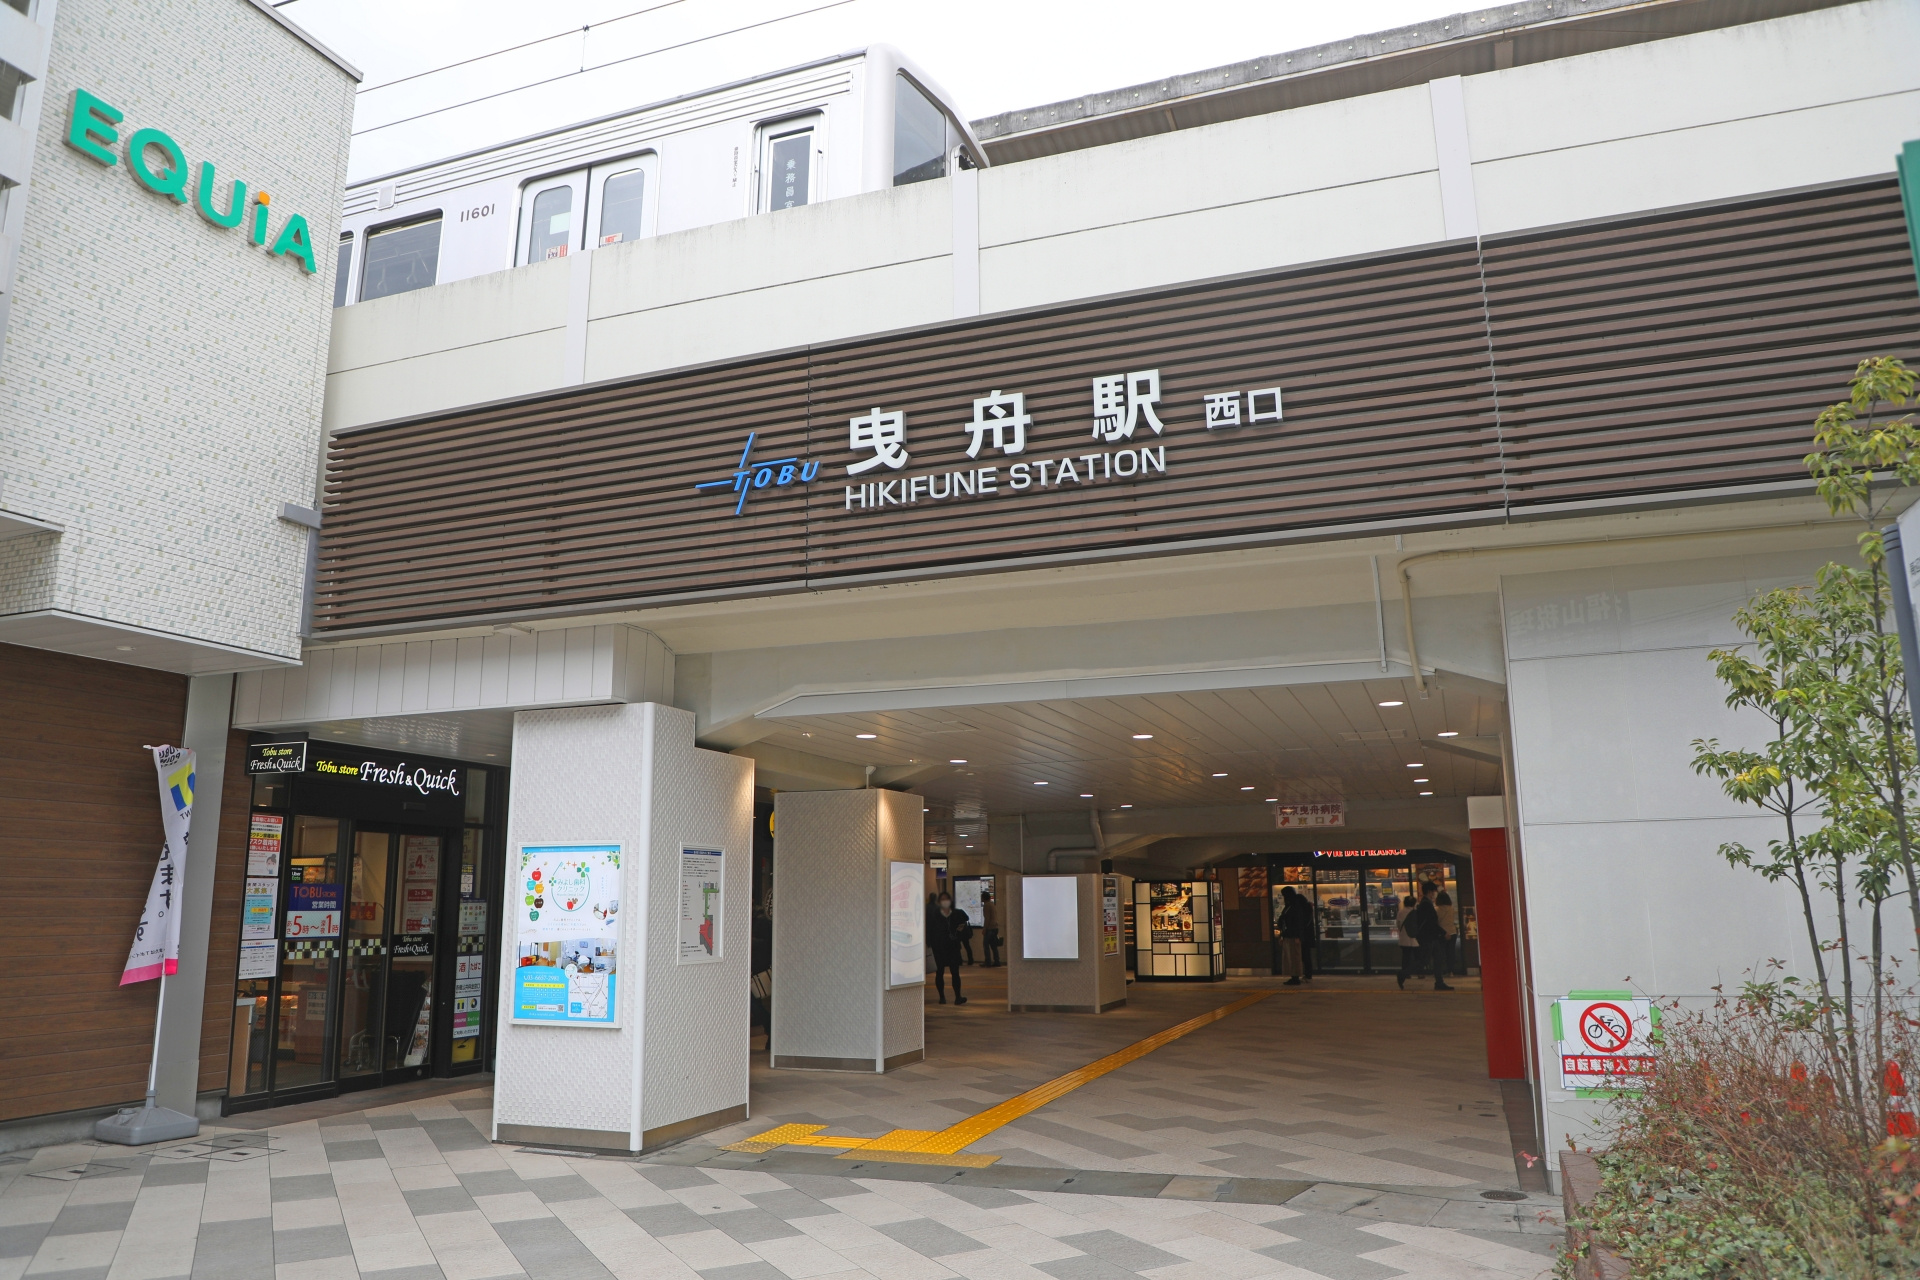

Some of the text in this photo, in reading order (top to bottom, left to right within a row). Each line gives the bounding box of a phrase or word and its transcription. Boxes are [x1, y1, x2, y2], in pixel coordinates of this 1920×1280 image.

[64, 88, 317, 275] EQUiA
[459, 203, 496, 224] 11601
[845, 368, 1285, 477] 曳舟駅 西口
[845, 445, 1167, 511] HIKIFUNE STATION
[262, 746, 293, 757] Tobu store
[316, 760, 338, 773] Tobu
[338, 765, 359, 776] store
[1278, 803, 1341, 816] 東京曳舟病院
[1297, 816, 1325, 825] 東口
[293, 886, 323, 898] TOBU
[311, 900, 337, 909] 営業時間
[458, 962, 481, 973] 酒 たばこ
